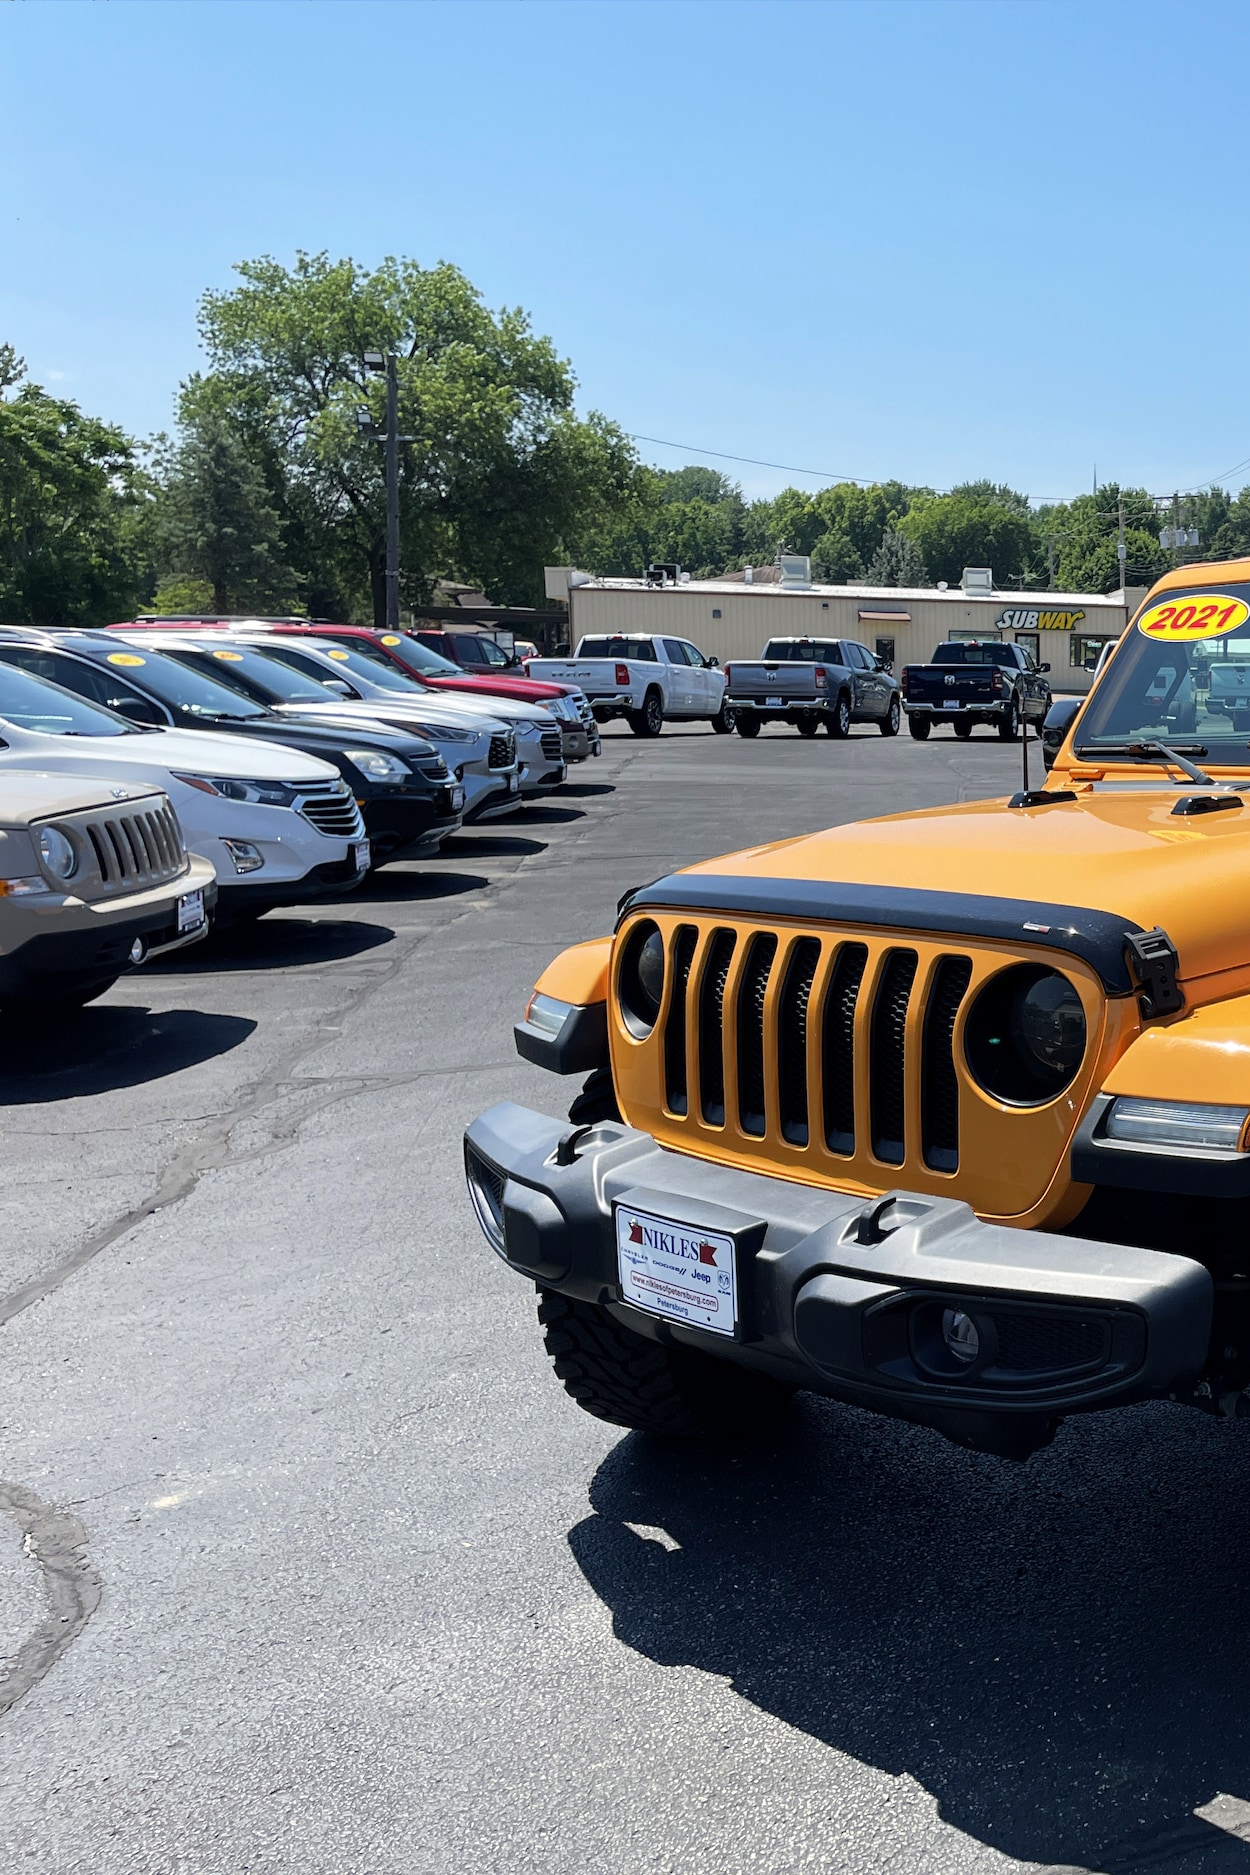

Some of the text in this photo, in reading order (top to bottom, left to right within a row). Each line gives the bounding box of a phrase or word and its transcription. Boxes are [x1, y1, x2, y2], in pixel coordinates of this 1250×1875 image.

[995, 609, 1086, 631] SUBWAY
[1147, 604, 1238, 631] 2021
[642, 1226, 701, 1262] NIKLES
[620, 1246, 648, 1260] CHRYSLER
[691, 1268, 711, 1285] Jeep
[632, 1274, 717, 1308] www.niklesofpetersburg.com
[656, 1297, 689, 1316] Petersburg
